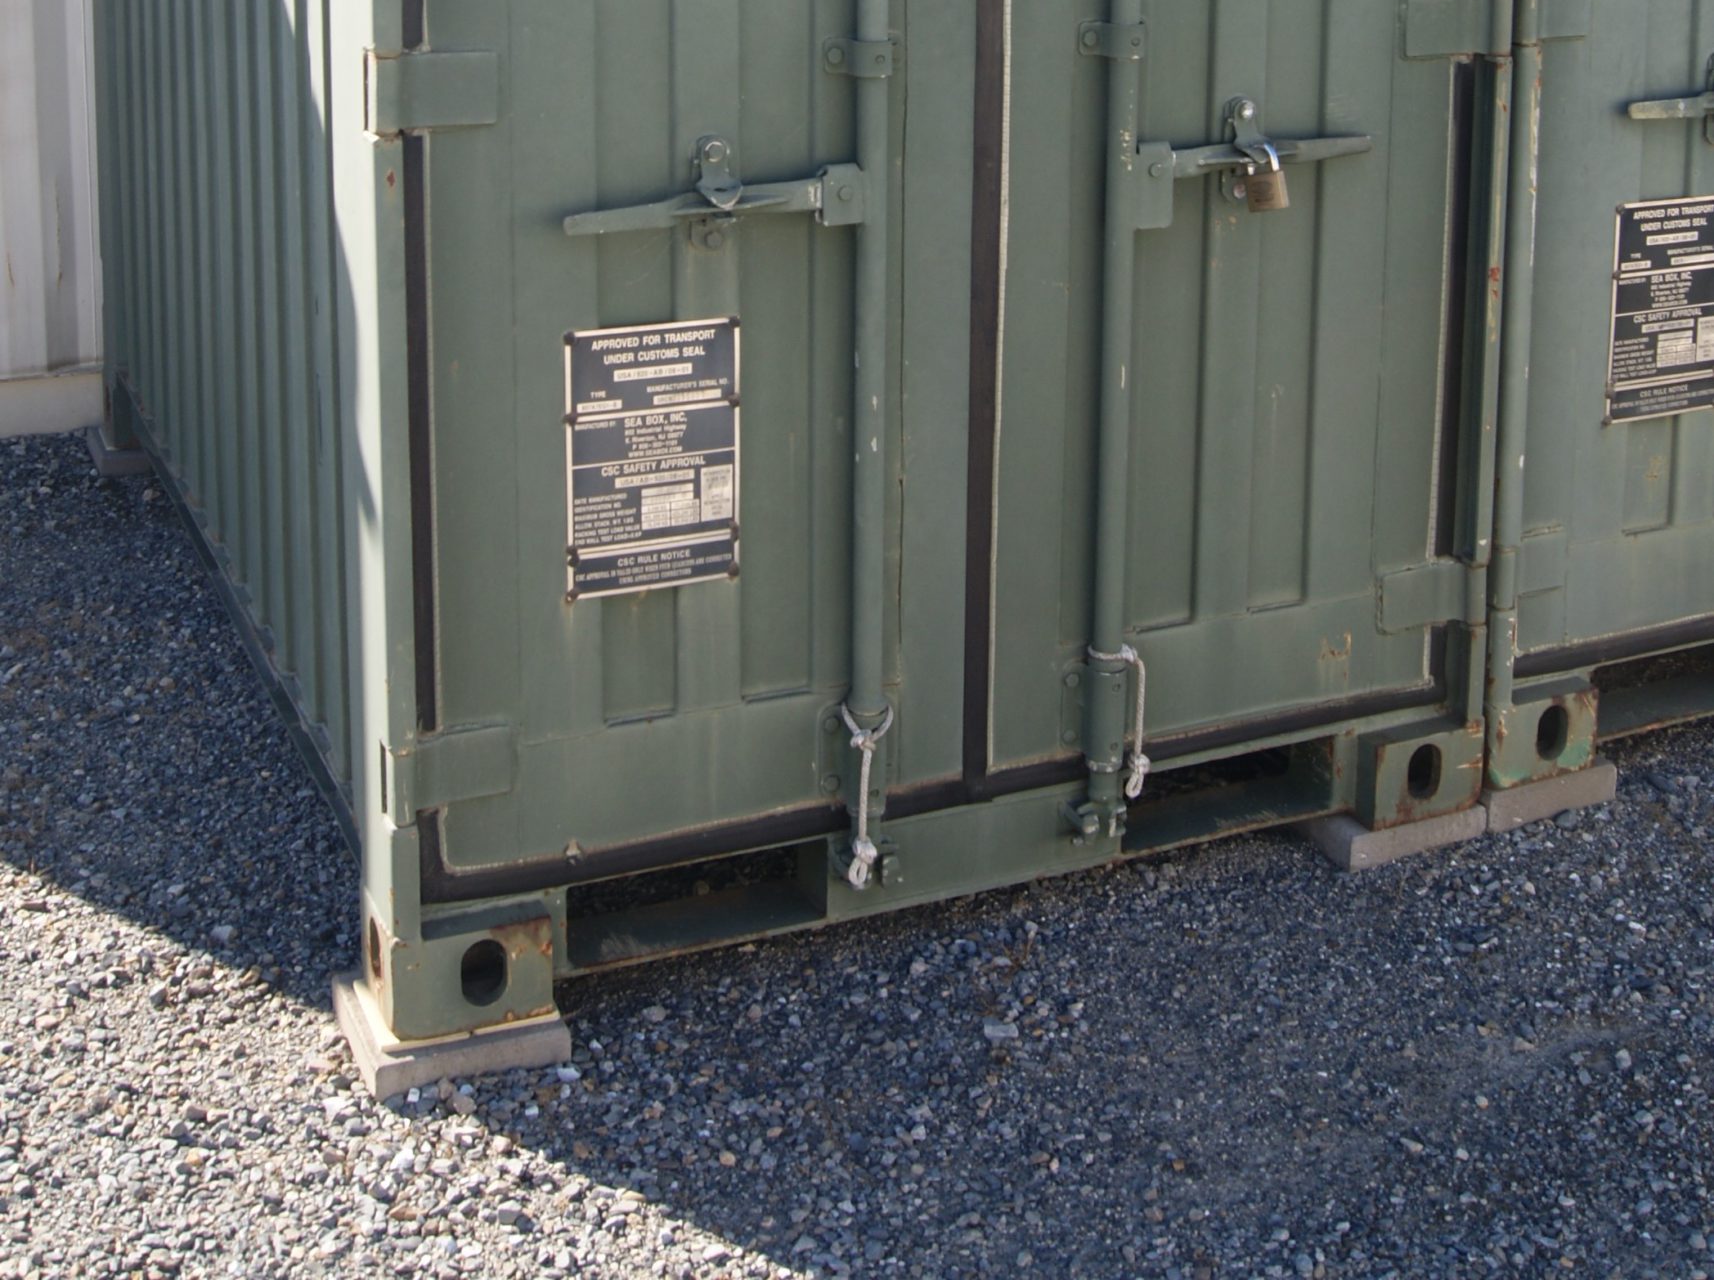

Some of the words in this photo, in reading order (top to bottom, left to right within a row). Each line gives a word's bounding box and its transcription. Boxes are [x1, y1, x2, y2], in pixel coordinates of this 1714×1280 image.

[592, 337, 639, 351] APPROVED
[643, 334, 661, 346] FOR
[665, 329, 715, 343] TRANSPORT
[604, 353, 634, 365] UNDER
[638, 349, 679, 361] CUSTOMS
[683, 346, 705, 356] SEAL
[624, 417, 642, 427] SEA
[601, 467, 621, 477] CSC
[624, 462, 658, 474] SAFETY
[660, 456, 706, 469] APPROVAL
[617, 557, 635, 567] CSC
[637, 554, 659, 564] RULE
[661, 549, 691, 561] NOTICE
